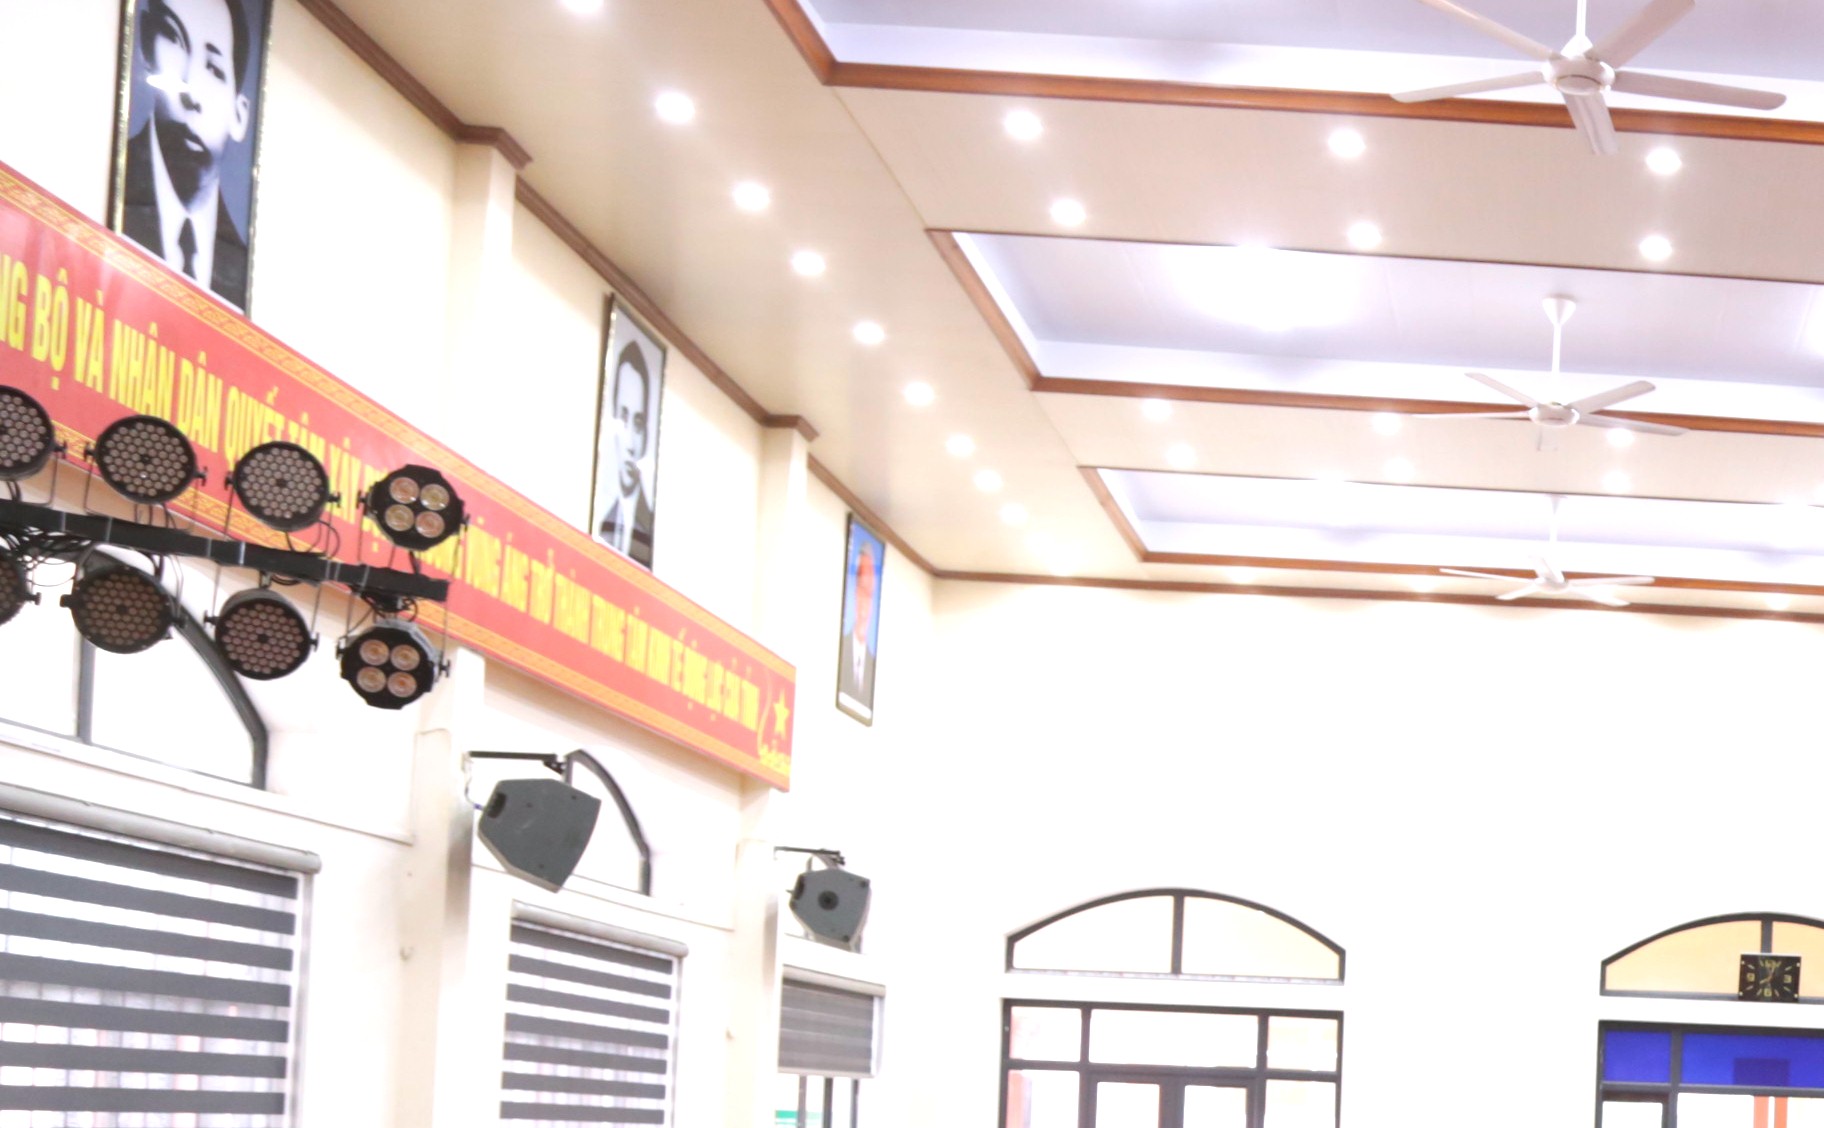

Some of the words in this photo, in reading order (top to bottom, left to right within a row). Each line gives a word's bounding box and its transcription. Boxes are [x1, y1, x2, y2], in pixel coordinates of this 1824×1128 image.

[32, 267, 69, 391] BỘ
[74, 289, 104, 393] VÀ
[109, 321, 175, 422] NHÂN
[177, 351, 223, 453] DÂN
